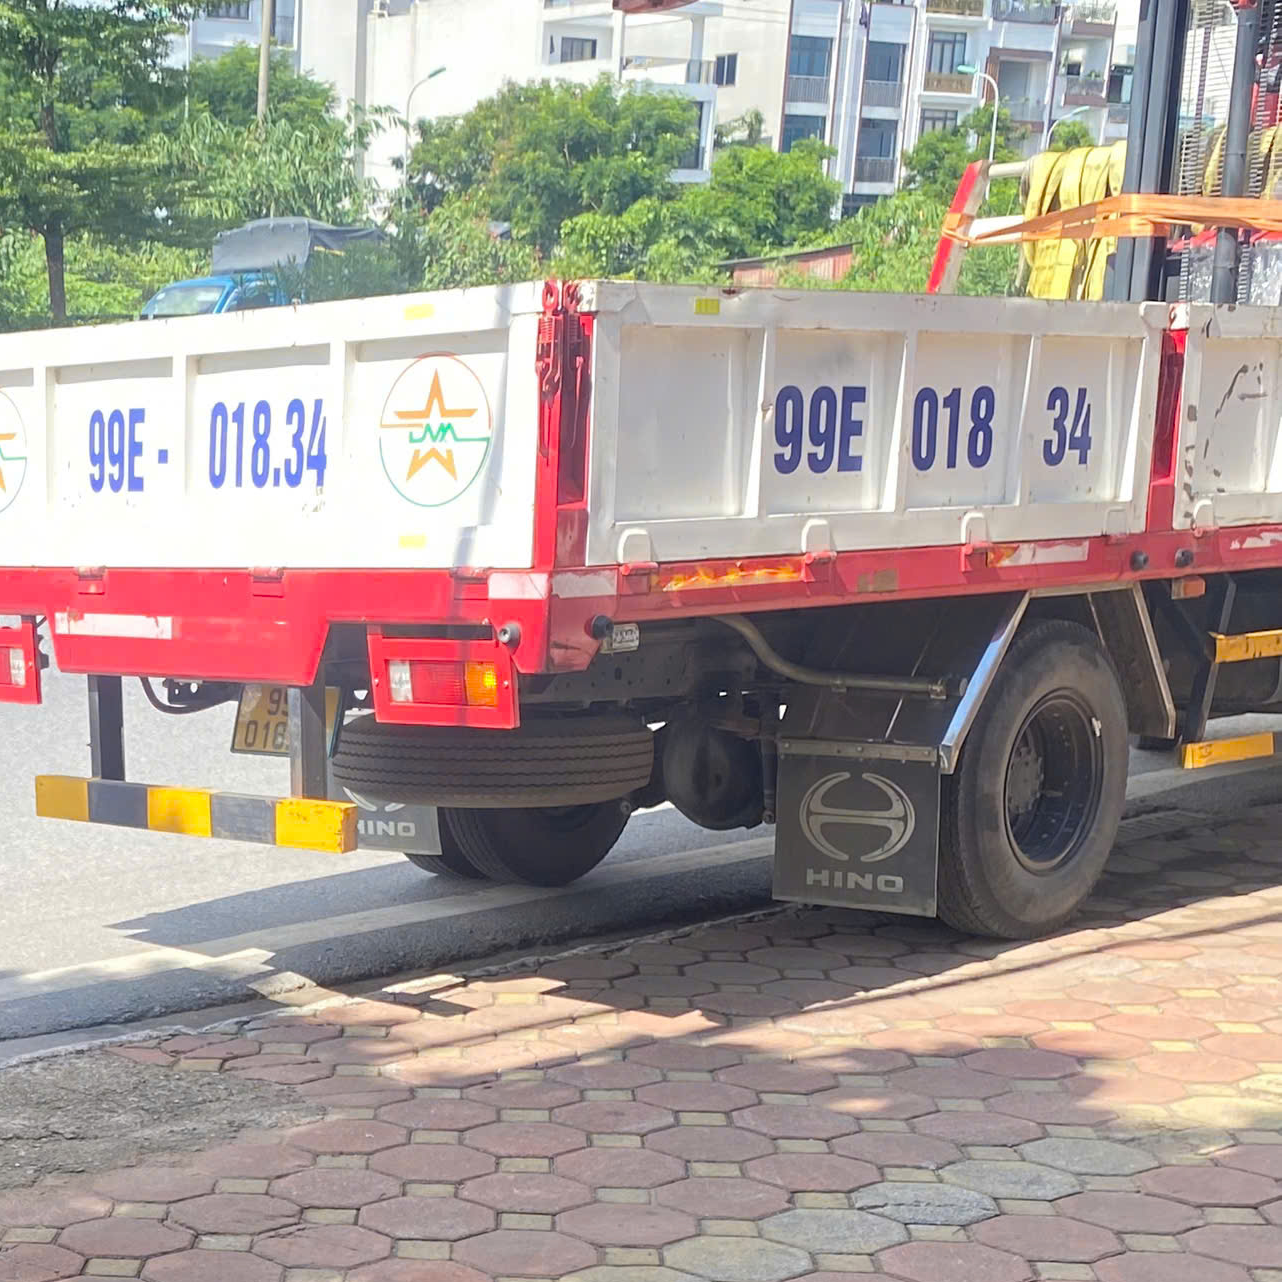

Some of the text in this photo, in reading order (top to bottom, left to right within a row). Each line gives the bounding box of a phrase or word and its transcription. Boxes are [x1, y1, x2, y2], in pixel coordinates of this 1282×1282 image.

[209, 398, 327, 489] 018.34
[774, 385, 1092, 474] 99E 018 34
[806, 868, 904, 893] HINO
